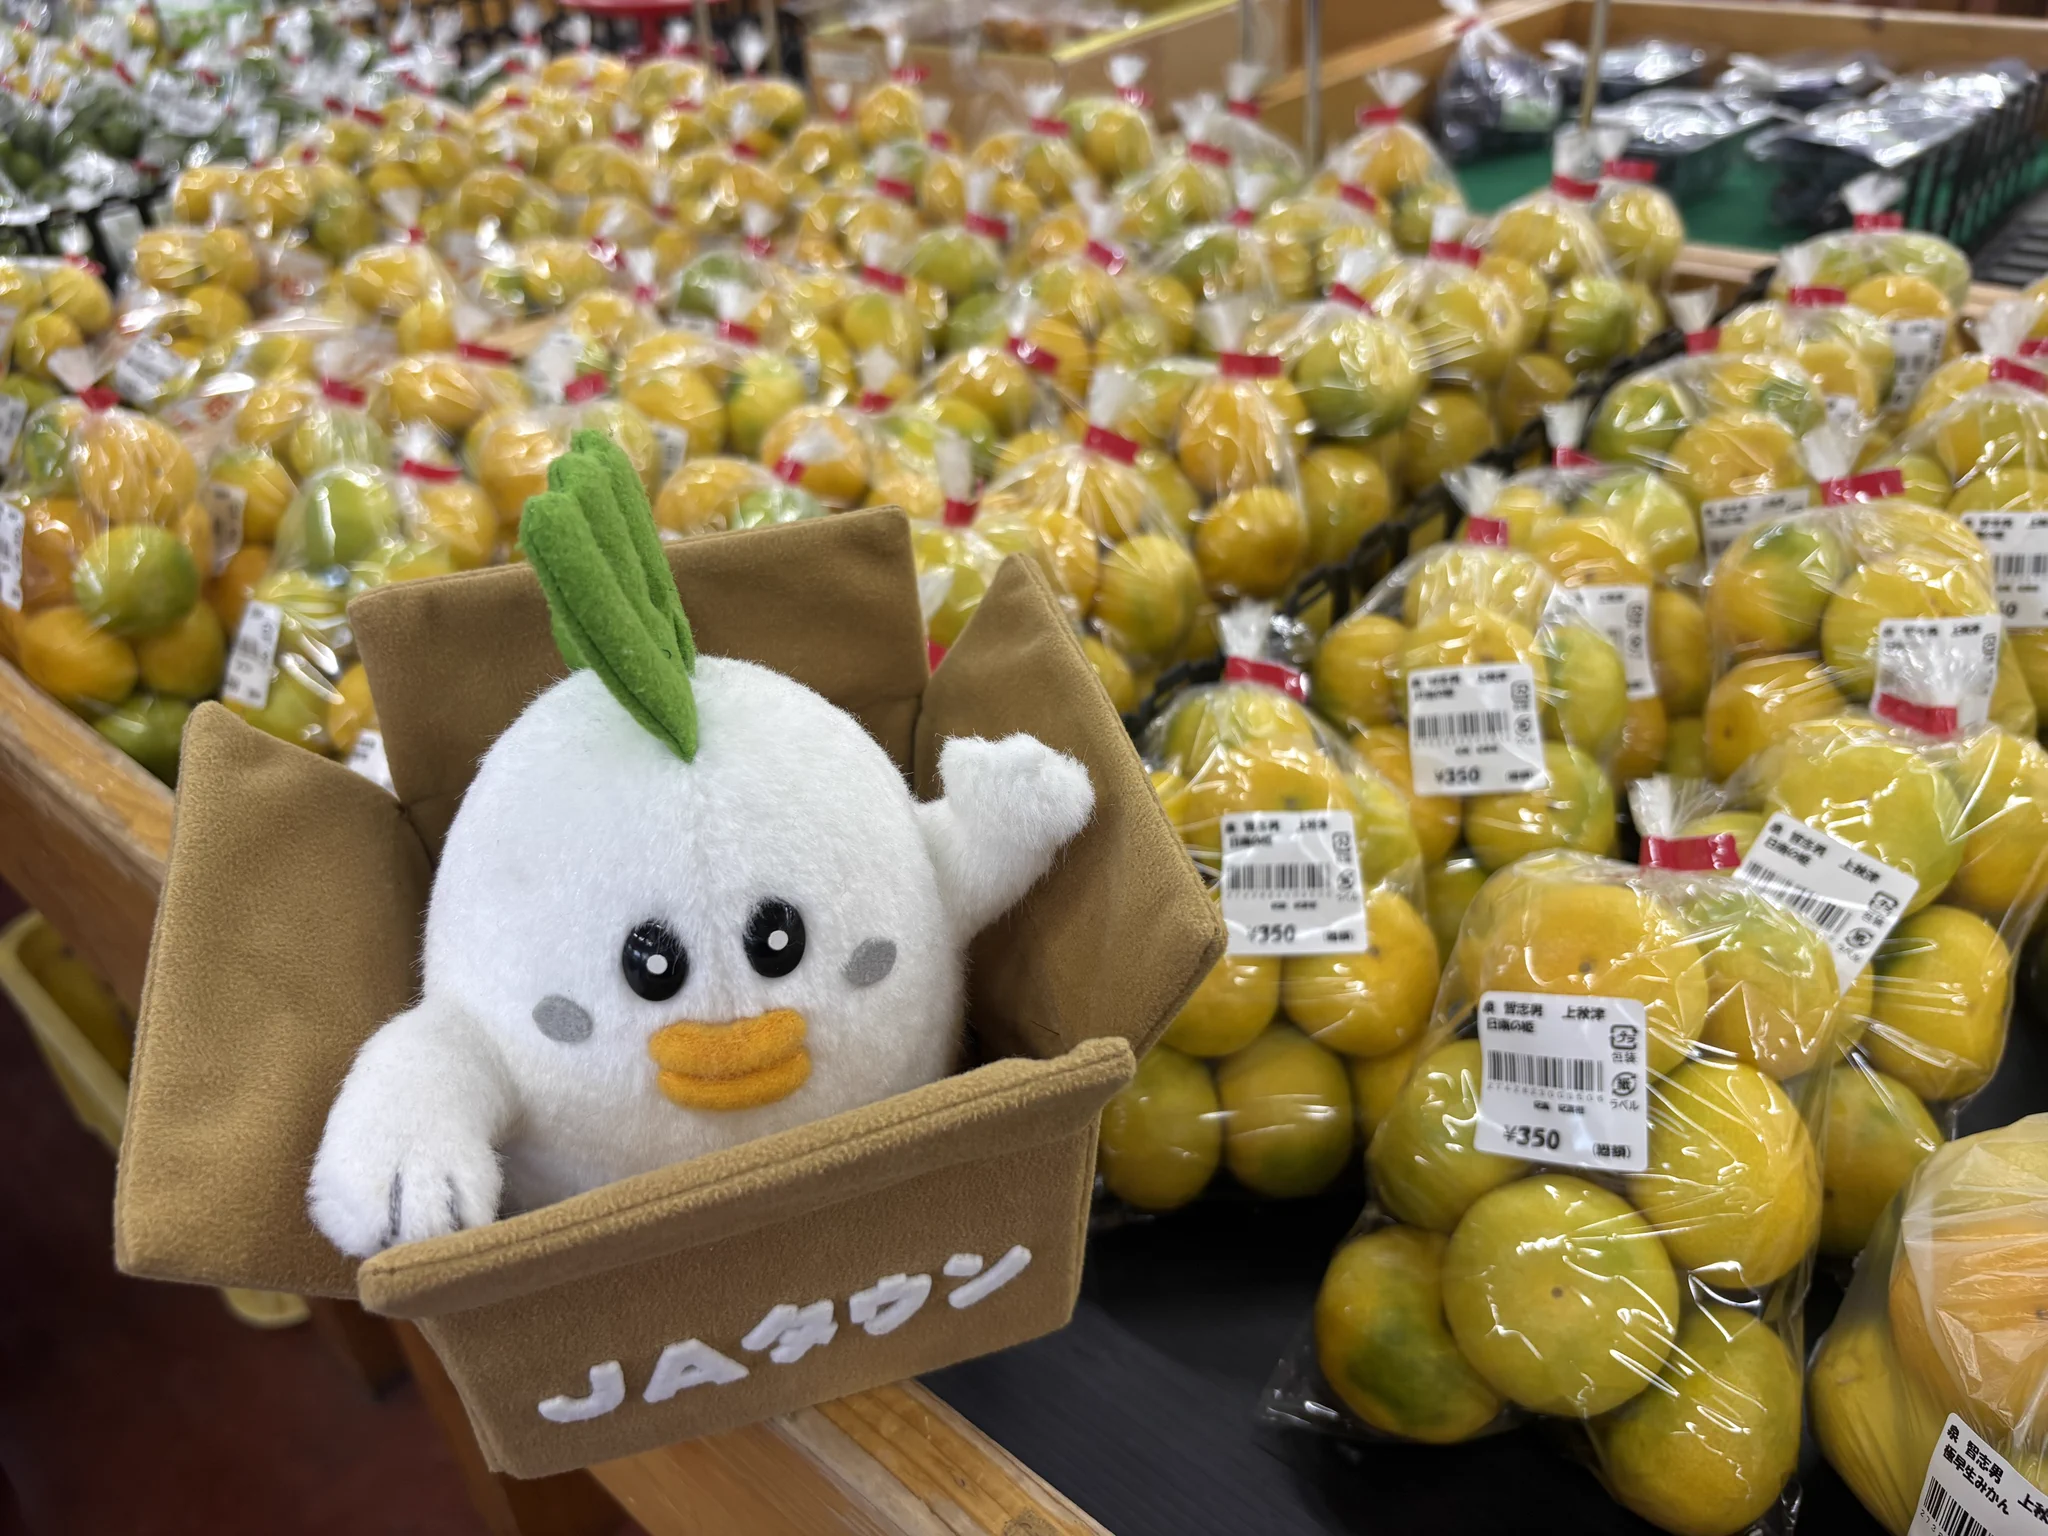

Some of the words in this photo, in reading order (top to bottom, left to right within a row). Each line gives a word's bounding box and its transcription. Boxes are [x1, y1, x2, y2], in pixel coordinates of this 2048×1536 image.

[1504, 1124, 1560, 1150] ¥350
[1943, 1444, 2009, 1515] 極早生みかん
[1965, 1440, 2004, 1484] 智志男
